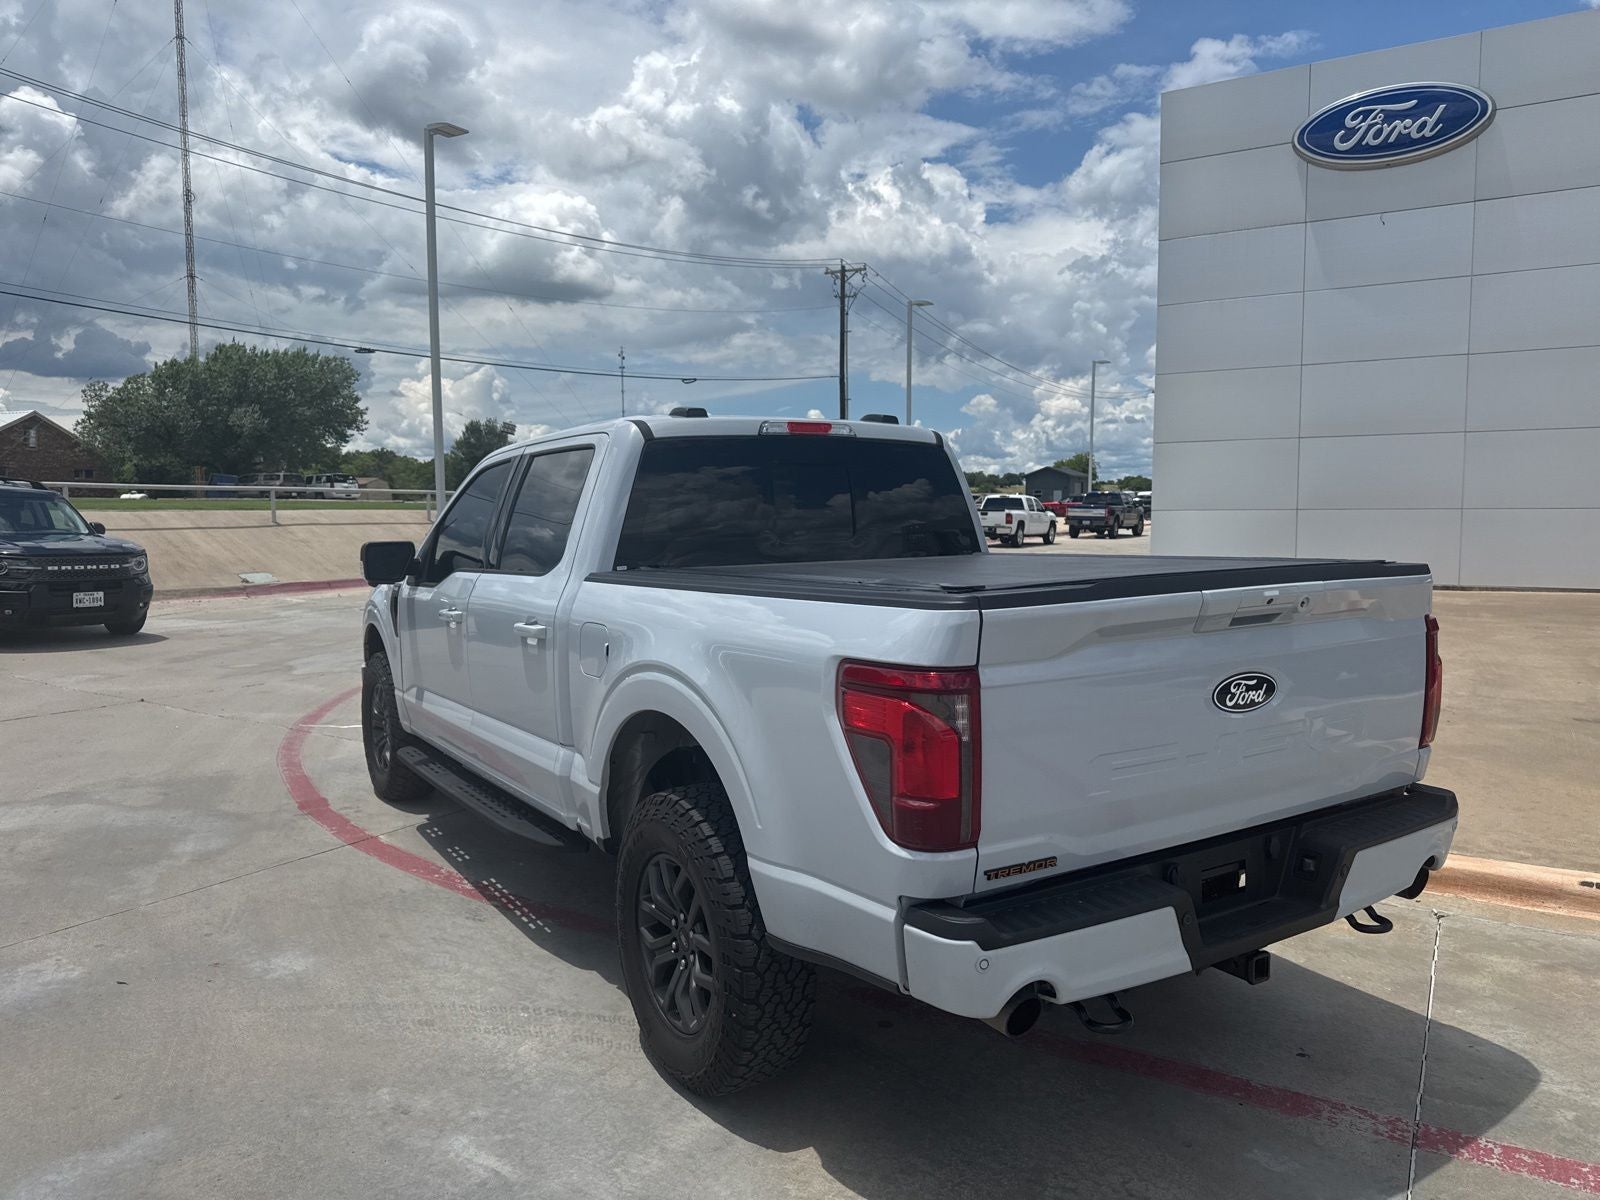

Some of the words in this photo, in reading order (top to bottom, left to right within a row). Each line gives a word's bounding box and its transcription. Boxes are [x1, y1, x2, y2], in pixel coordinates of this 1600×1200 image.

[1333, 99, 1448, 151] Ford
[1225, 679, 1267, 707] Ford
[983, 855, 1058, 881] TREMOR
